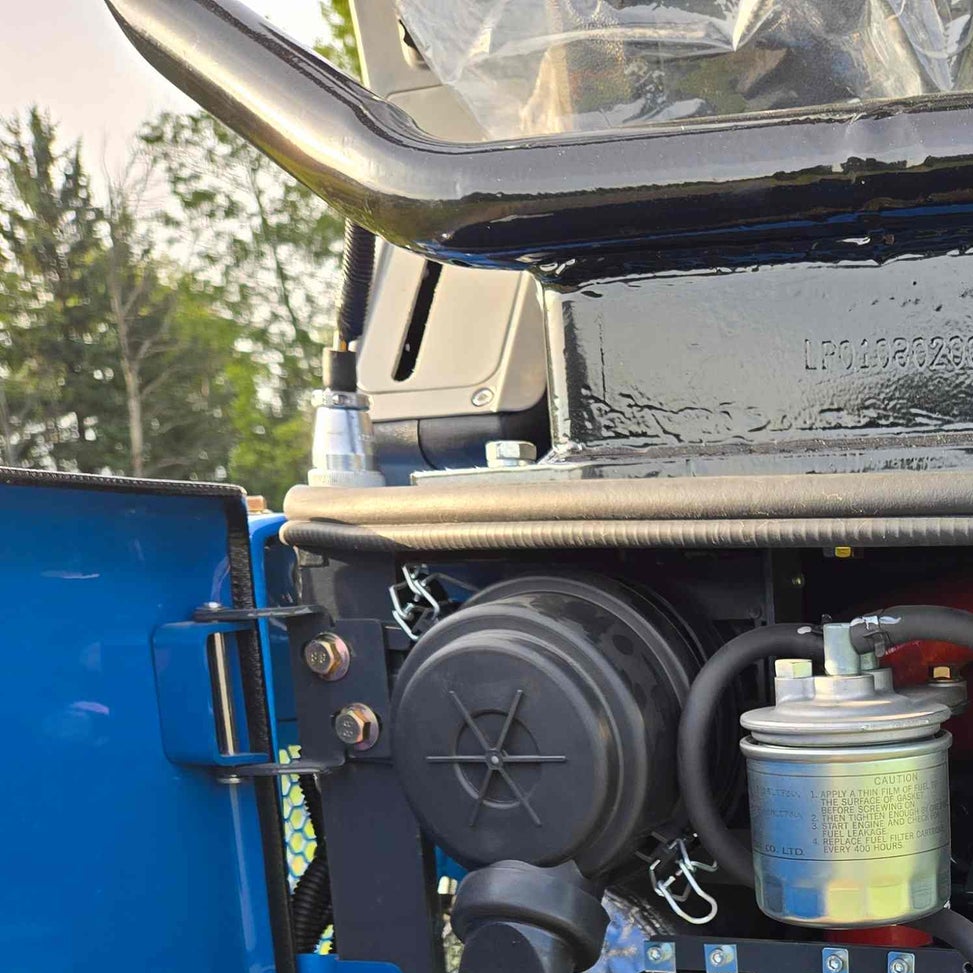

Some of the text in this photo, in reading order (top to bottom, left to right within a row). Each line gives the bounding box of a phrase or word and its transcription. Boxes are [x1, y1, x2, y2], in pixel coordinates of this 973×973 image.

[874, 773, 918, 785] CAUTION
[810, 790, 818, 799] 1.
[820, 789, 848, 798] APPLY
[850, 789, 857, 798] A
[858, 788, 879, 798] THIN
[881, 786, 900, 796] FILM
[902, 784, 912, 794] OF
[820, 791, 924, 806] THE SURFACE OF GASKET
[821, 805, 855, 815] BEFORE
[857, 802, 903, 813] SCREWING
[904, 800, 916, 809] ON
[821, 814, 846, 822] THEN
[848, 811, 885, 822] TIGHTEN
[888, 808, 919, 819] ENOUGH
[822, 821, 849, 830] START
[852, 819, 884, 829] ENGINE
[887, 817, 905, 827] AND
[822, 830, 845, 838] FUEL
[823, 837, 861, 846] REPLACE
[865, 834, 888, 844] FUEL
[890, 831, 914, 842] FILTER
[782, 846, 806, 857] LTD.
[824, 845, 851, 854] EVERY
[853, 844, 871, 853] 400
